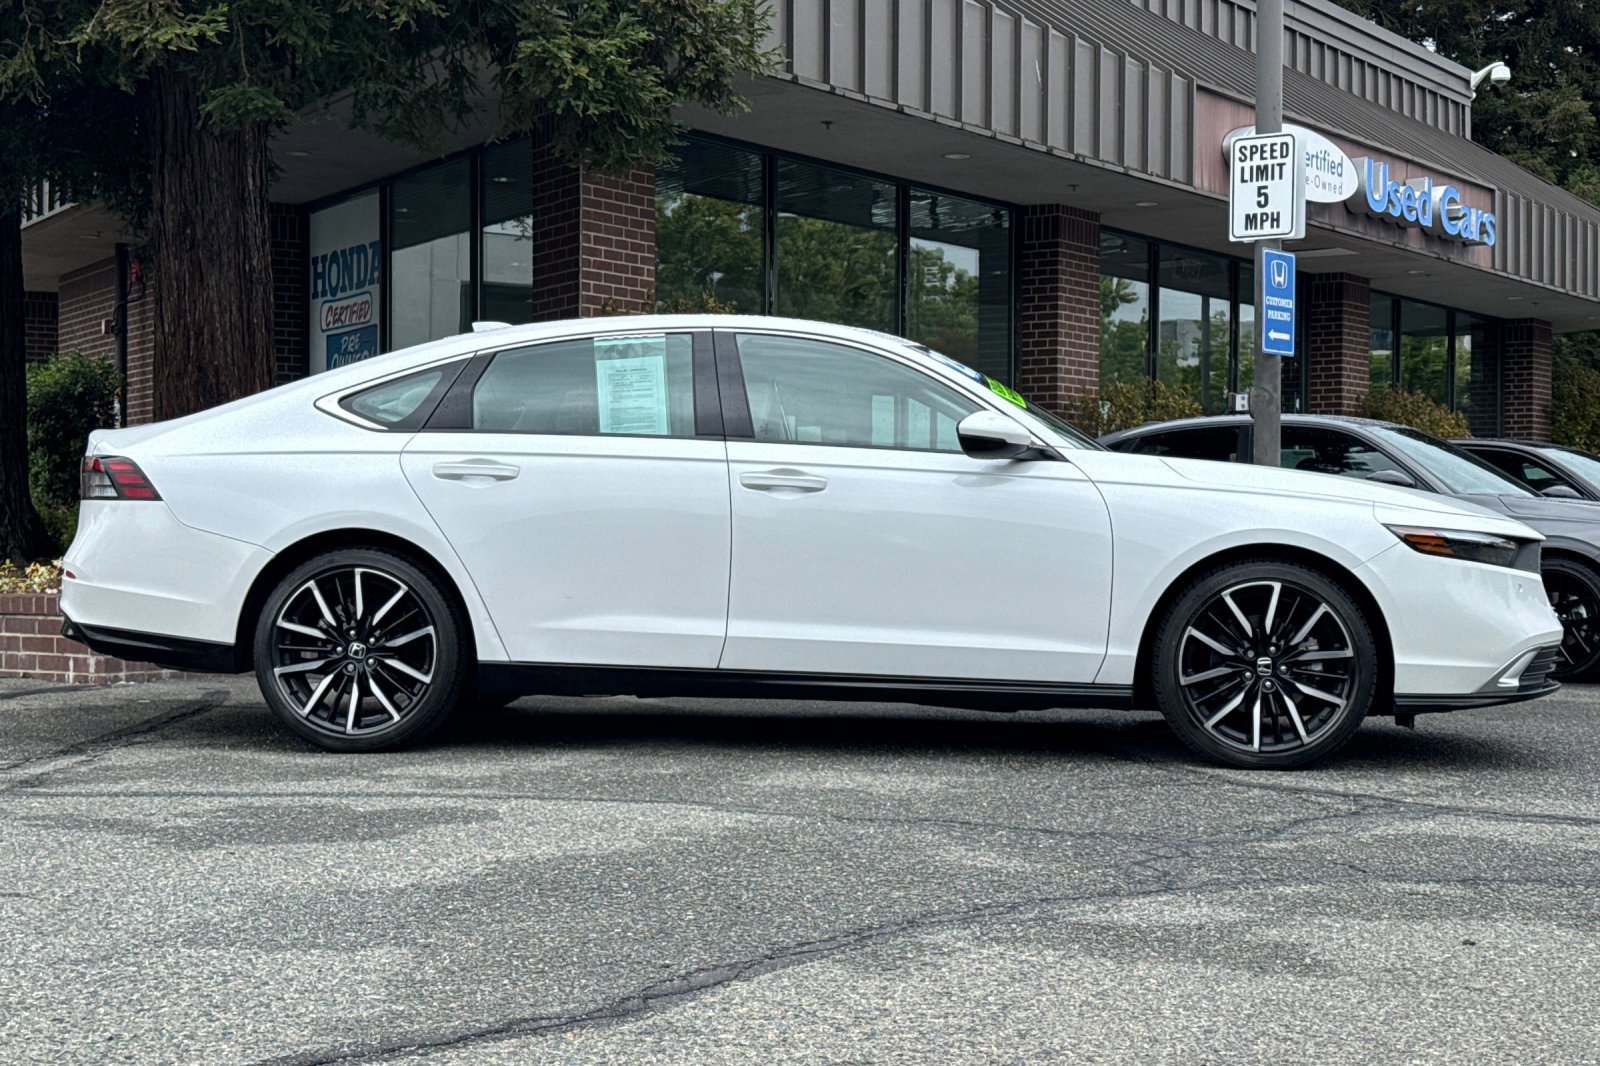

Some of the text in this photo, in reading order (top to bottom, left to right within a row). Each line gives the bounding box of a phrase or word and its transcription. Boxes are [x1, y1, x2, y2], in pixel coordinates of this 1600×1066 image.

[1238, 142, 1289, 163] SPEED
[1305, 149, 1344, 178] ertified
[1240, 162, 1287, 184] LIMIT
[1305, 174, 1343, 196] e-Owned
[1256, 185, 1270, 209] 5
[1365, 156, 1496, 246] Used Cars
[1244, 210, 1281, 231] MPH
[311, 240, 382, 300] HONDA
[325, 300, 370, 328] CERTIFIED
[341, 332, 360, 353] PRE
